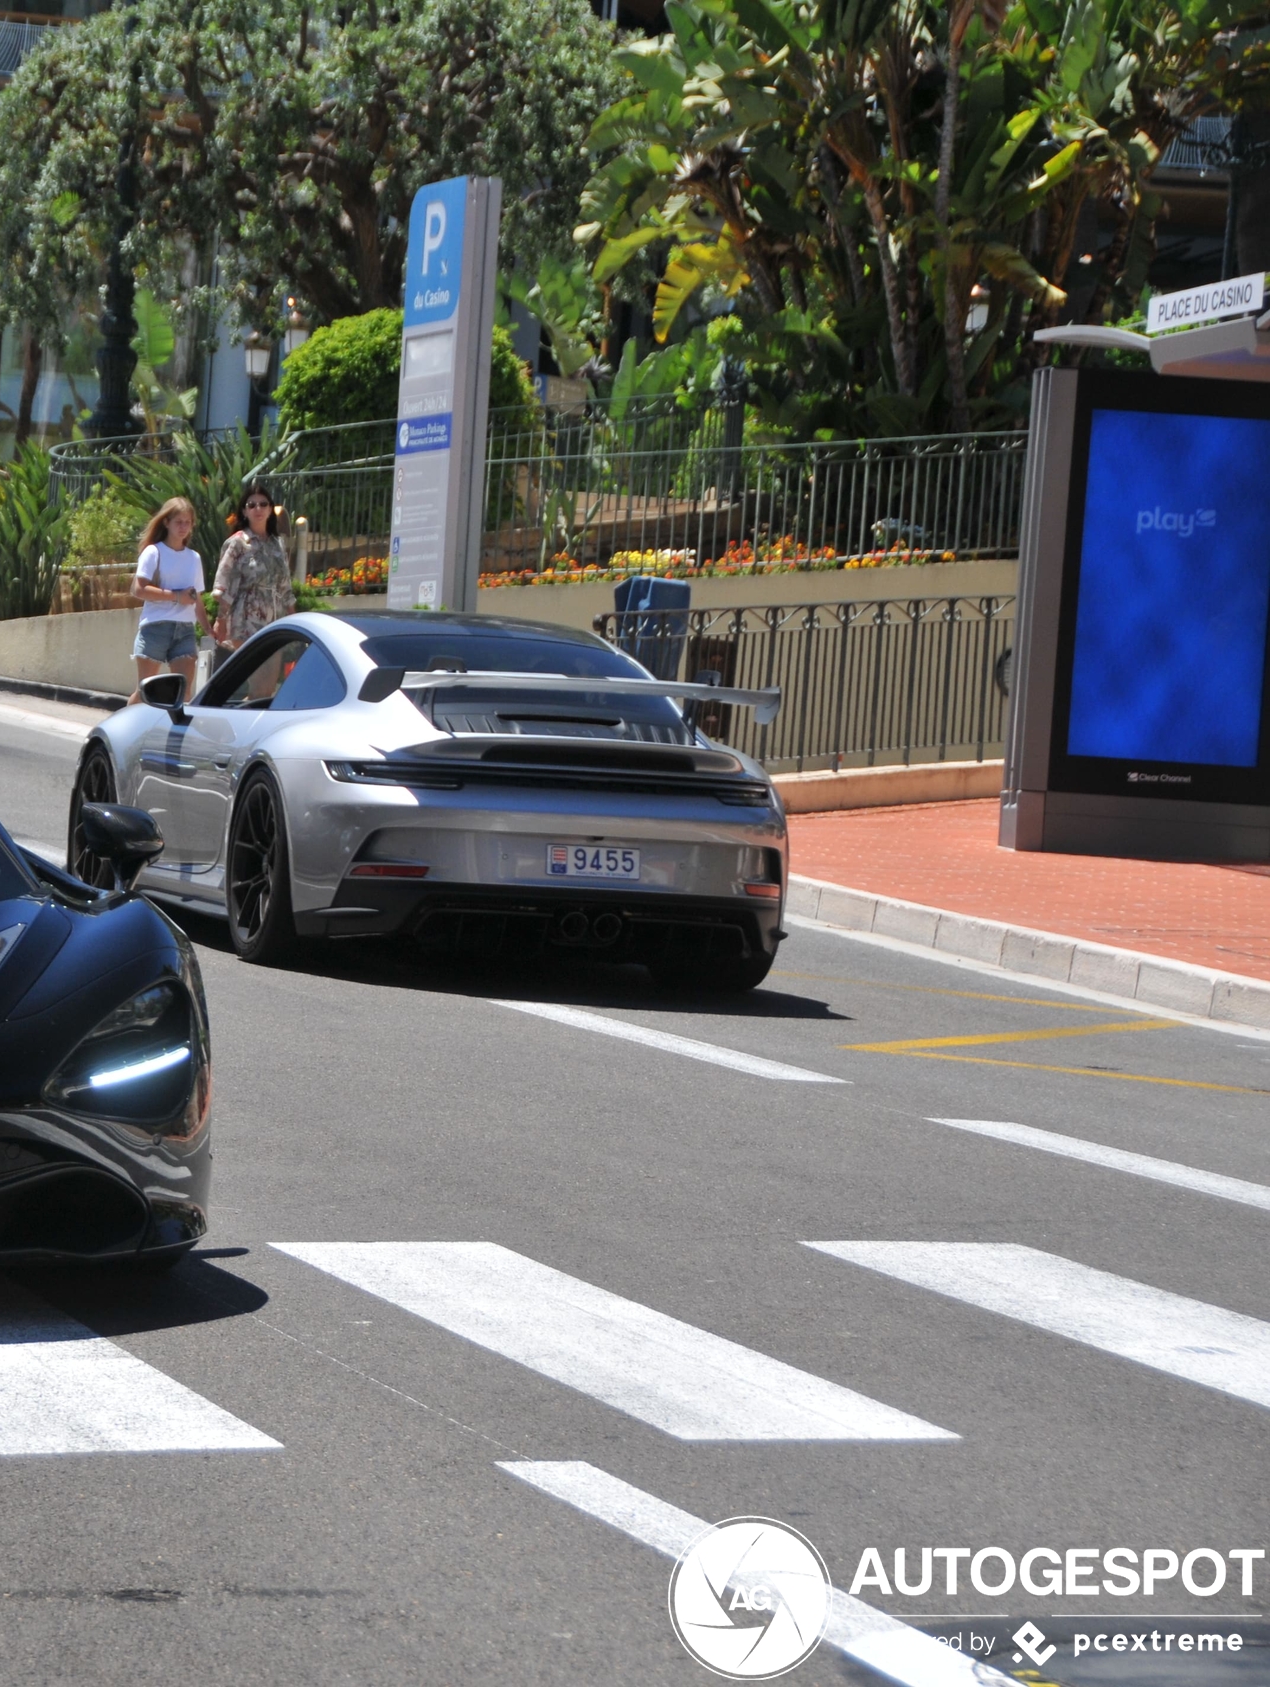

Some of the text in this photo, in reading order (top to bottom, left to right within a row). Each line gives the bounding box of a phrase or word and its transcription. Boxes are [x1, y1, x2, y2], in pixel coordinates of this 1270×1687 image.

[421, 202, 447, 275] P
[414, 287, 450, 310] du Casino
[1158, 283, 1253, 322] PLACE DU CASINO
[1136, 506, 1195, 538] play
[1139, 773, 1191, 783] Clear Channel
[574, 848, 634, 873] 9455
